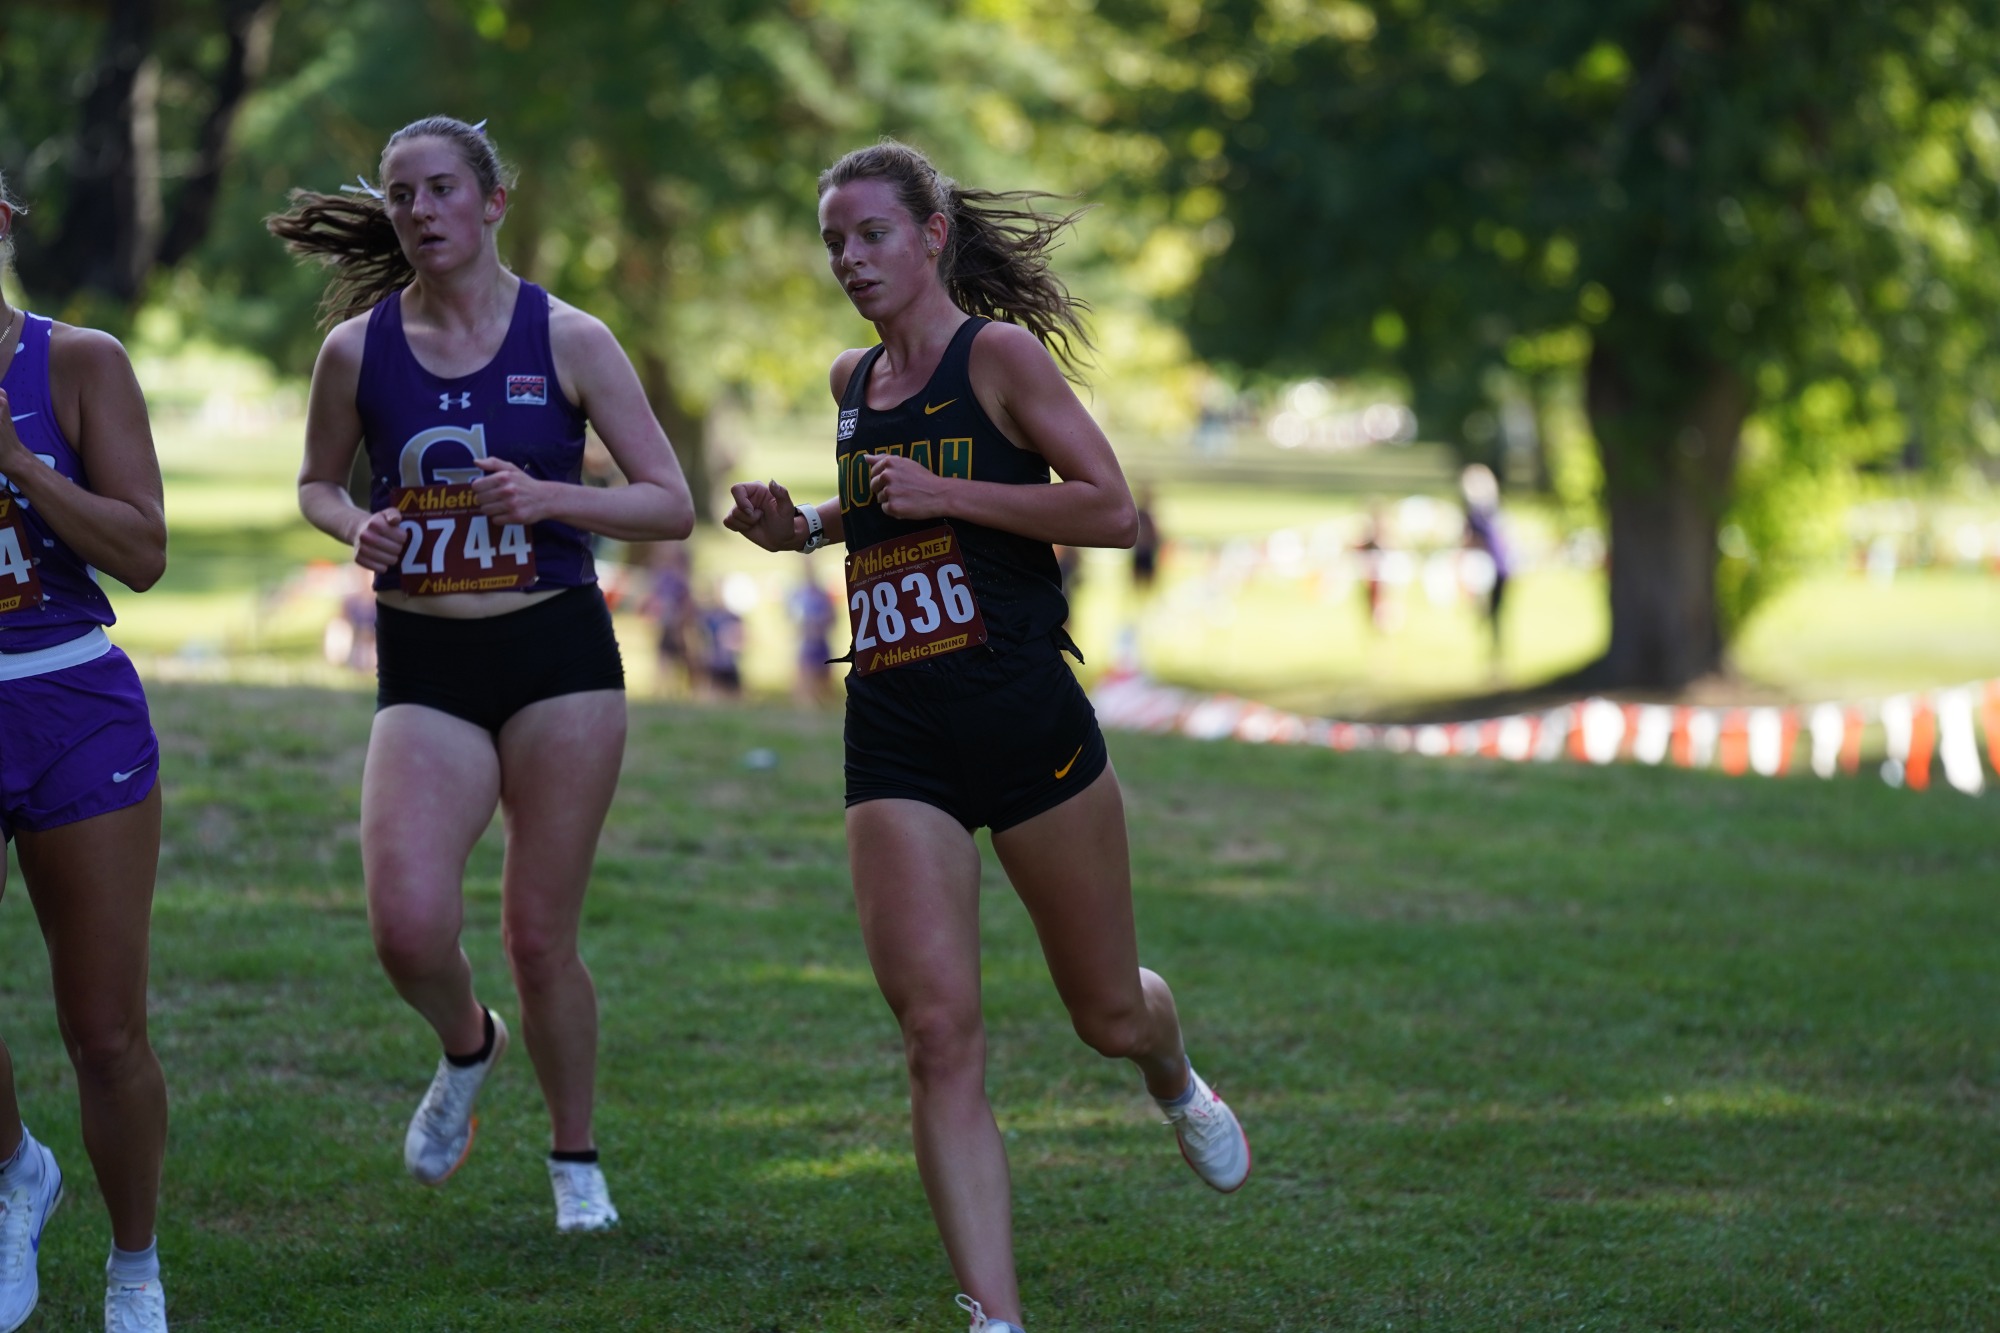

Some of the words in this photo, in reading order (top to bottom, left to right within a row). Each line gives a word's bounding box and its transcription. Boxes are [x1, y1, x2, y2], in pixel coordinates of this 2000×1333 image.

[510, 383, 544, 396] CCC
[399, 423, 488, 488] G
[399, 516, 532, 575] 2744
[851, 563, 975, 652] 2836
